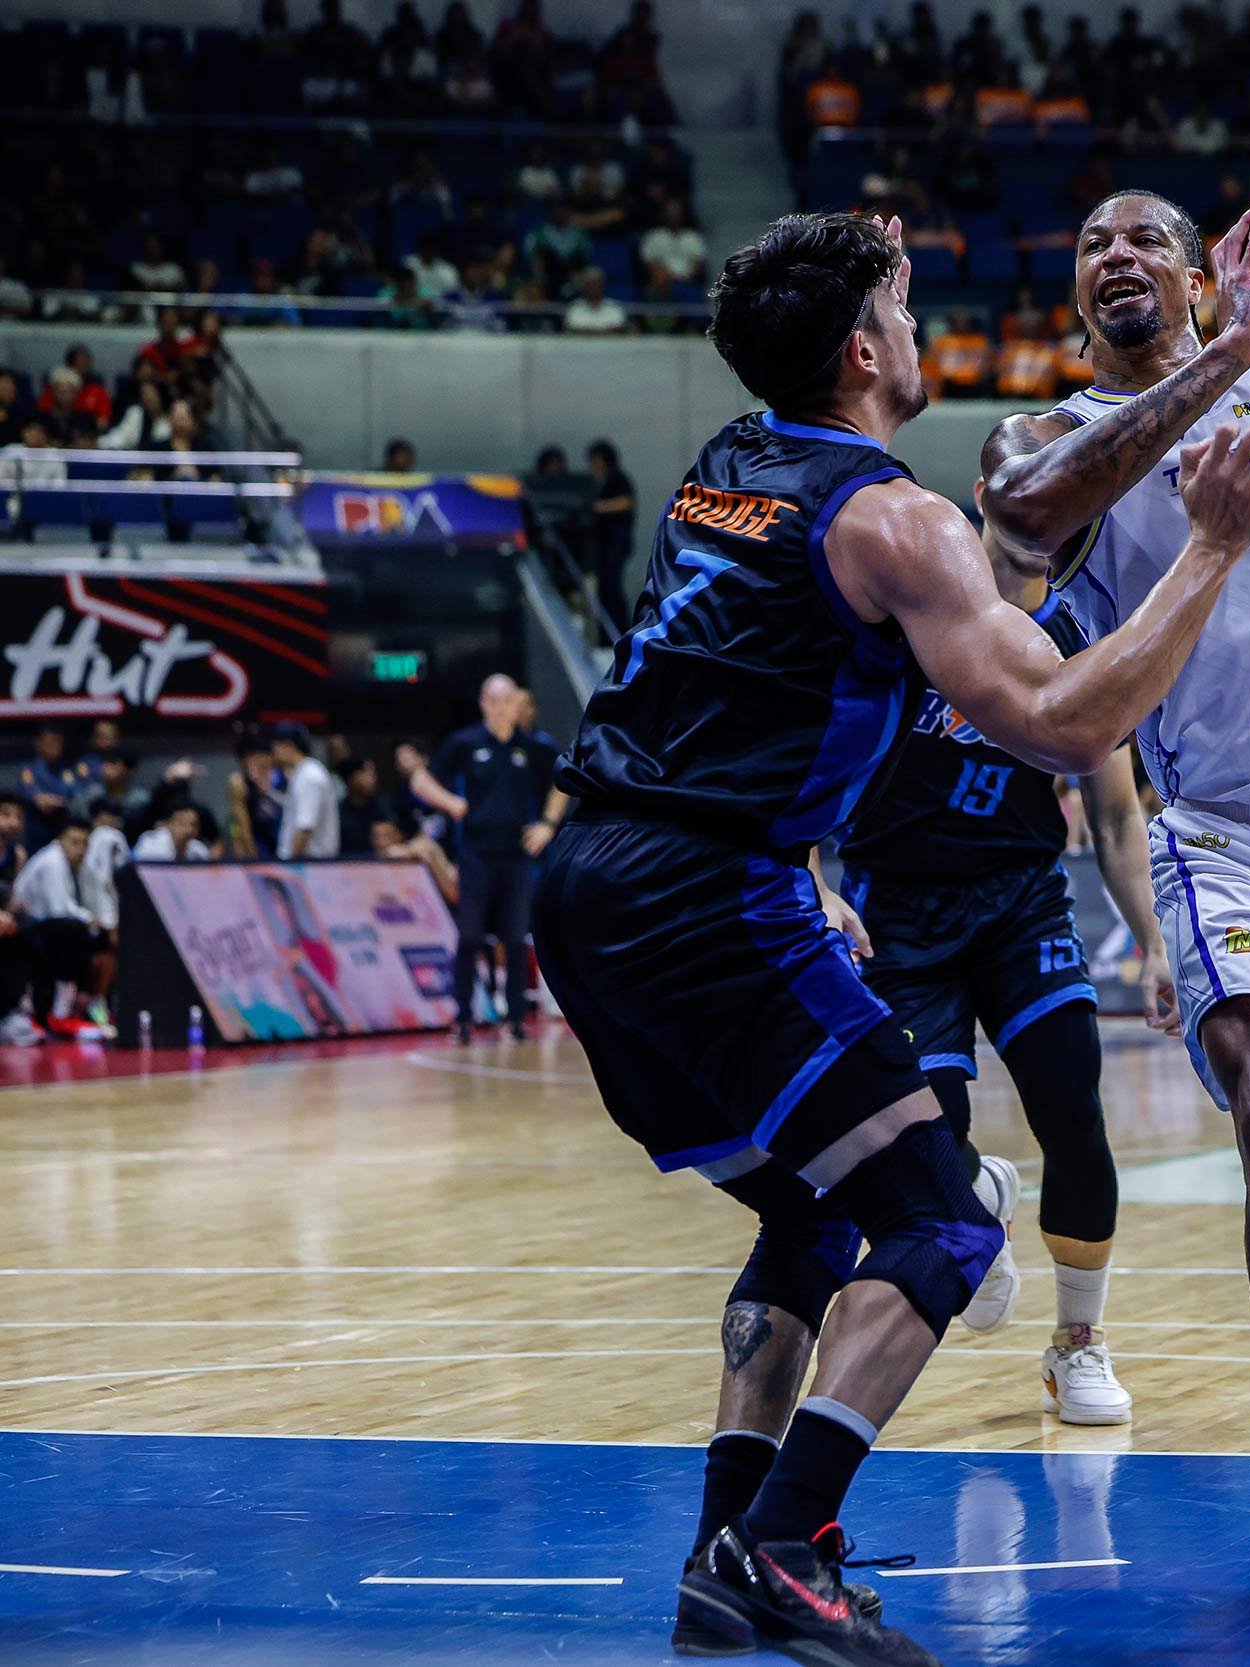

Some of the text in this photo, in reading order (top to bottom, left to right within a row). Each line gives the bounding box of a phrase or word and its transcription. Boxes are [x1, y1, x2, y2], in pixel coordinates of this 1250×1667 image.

[4, 606, 214, 704] Hut
[622, 548, 739, 684] 7
[947, 758, 1015, 817] 19
